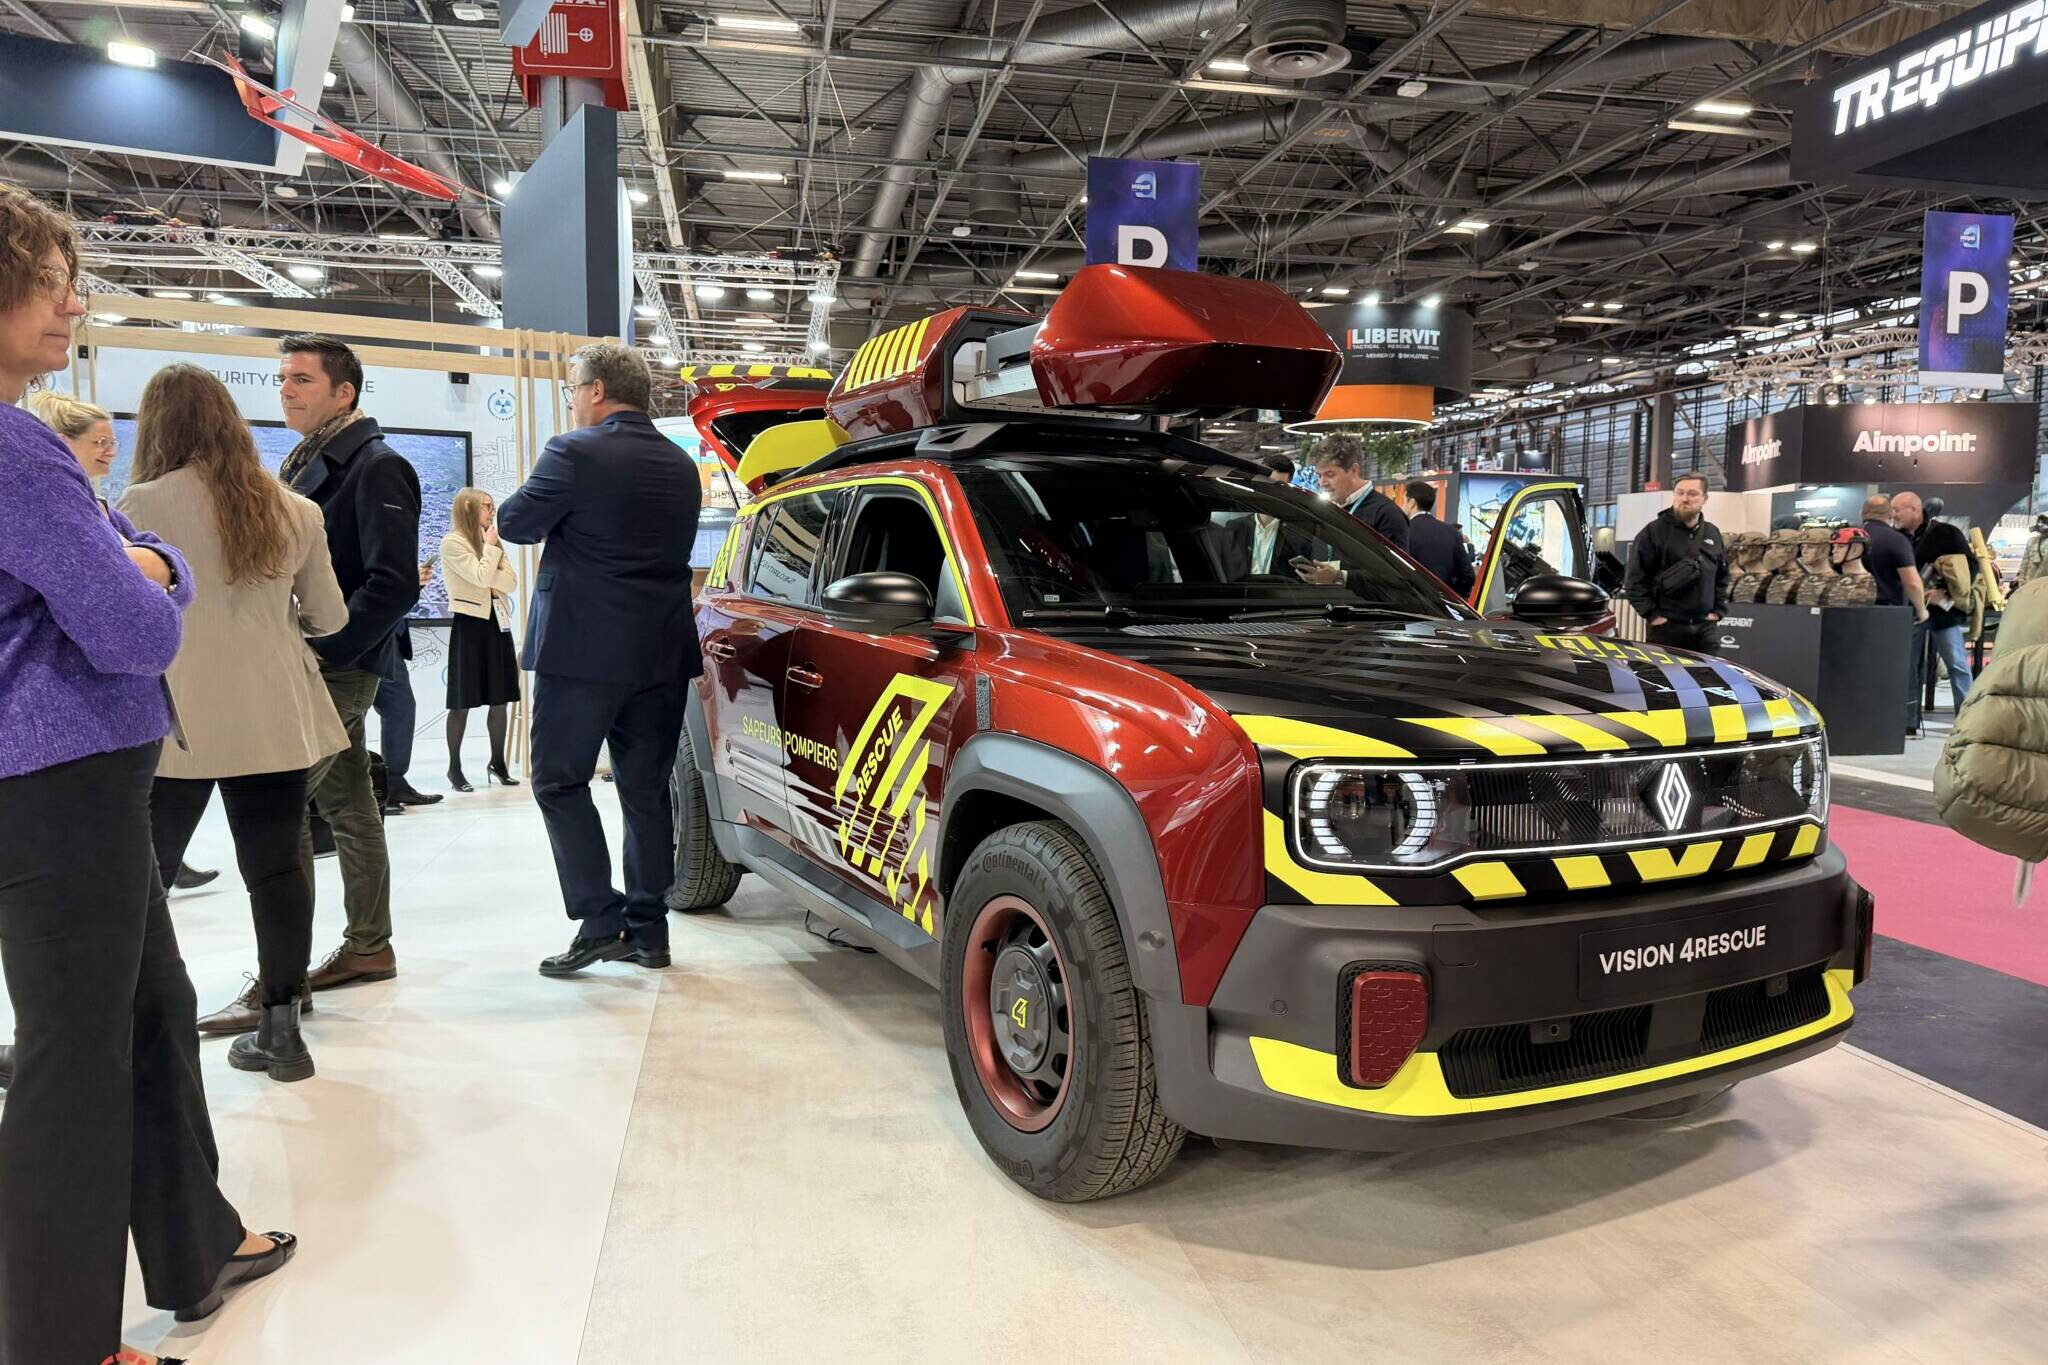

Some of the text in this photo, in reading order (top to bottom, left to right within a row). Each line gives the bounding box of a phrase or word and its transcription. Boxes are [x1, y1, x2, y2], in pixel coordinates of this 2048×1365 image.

[1946, 271, 1989, 334] P
[1352, 328, 1440, 345] LIBERVIT
[743, 714, 838, 771] SAPEURS POMPIERS
[855, 705, 903, 806] RESCUE
[1599, 925, 1767, 974] VISION 4RESCUE
